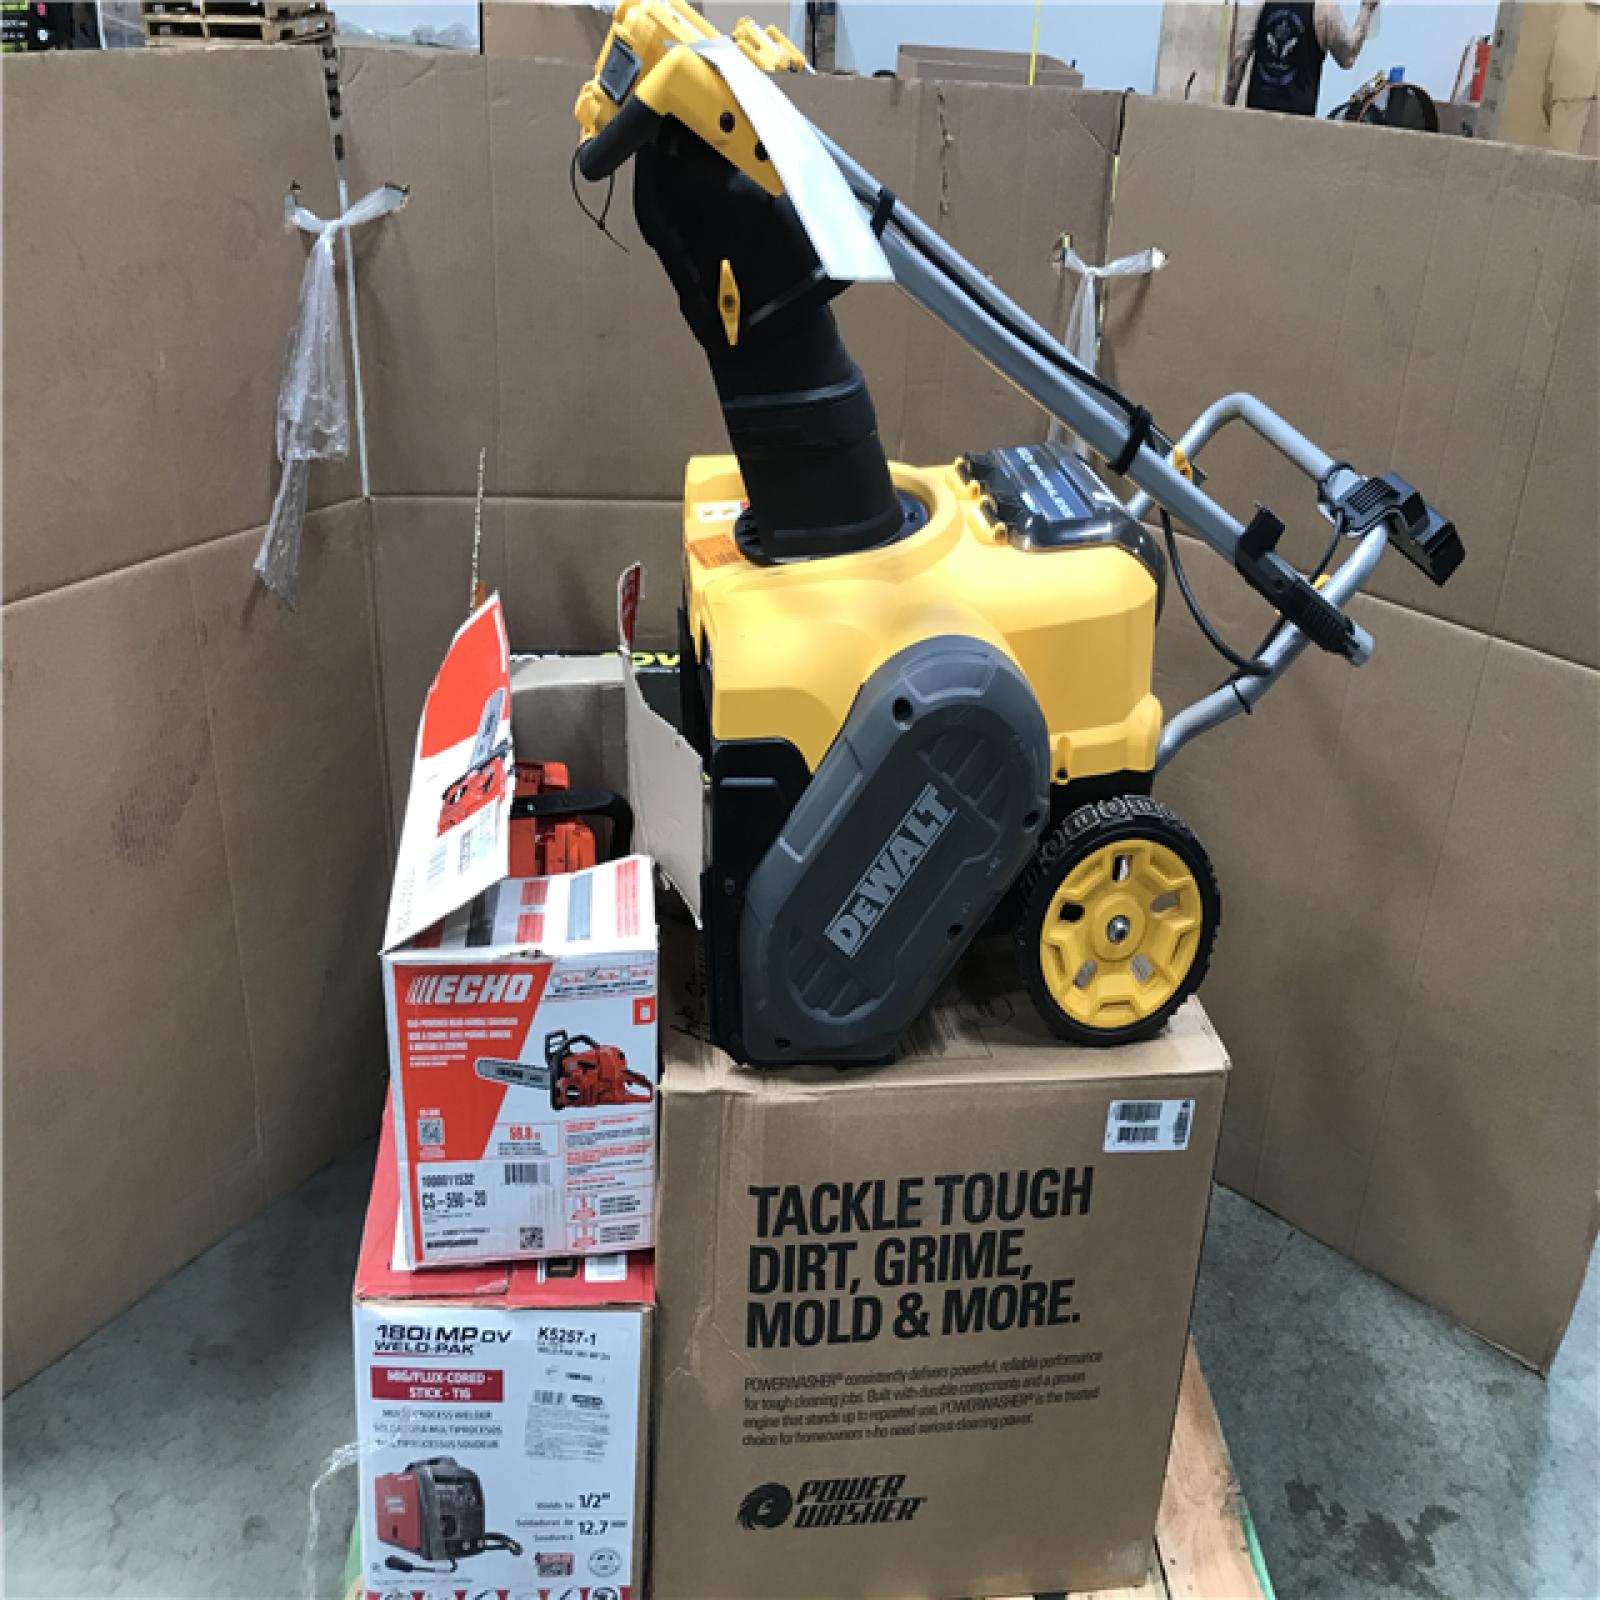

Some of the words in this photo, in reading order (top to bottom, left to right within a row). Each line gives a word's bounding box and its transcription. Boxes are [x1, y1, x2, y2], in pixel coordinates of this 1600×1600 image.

[824, 783, 957, 958] DEWALT
[433, 973, 534, 1003] ECHO
[747, 1177, 923, 1238] TACKLE
[934, 1165, 1094, 1226] TOUGH
[749, 1241, 860, 1295] DIRT,
[874, 1229, 1032, 1287] GRIME,
[746, 1295, 883, 1348] MOLD
[893, 1292, 929, 1339] &
[941, 1277, 1082, 1335] MORE.
[375, 1340, 473, 1354] WELD-PAK
[793, 1497, 924, 1528] WASHER
[796, 1474, 907, 1505] POWER
